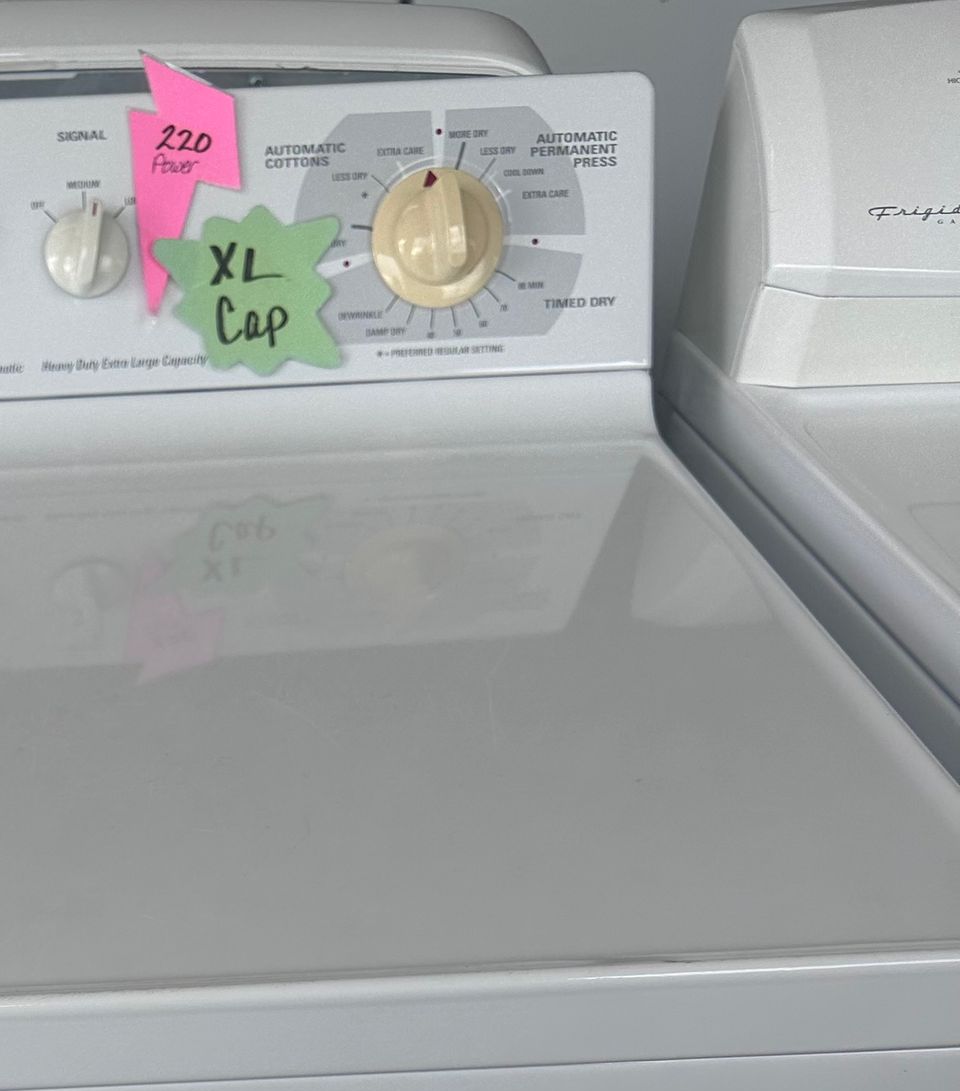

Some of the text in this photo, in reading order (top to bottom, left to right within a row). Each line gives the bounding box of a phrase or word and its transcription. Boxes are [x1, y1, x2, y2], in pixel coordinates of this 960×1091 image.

[56, 130, 107, 143] SIGNAL
[155, 124, 212, 153] 220
[448, 128, 489, 139] MORE DRY
[536, 130, 618, 144] AUTOMATIC
[264, 142, 346, 157] AUTOMATIC
[376, 146, 425, 158] EXTRA CARE
[479, 146, 516, 156] LESS DRY
[530, 143, 618, 157] PERMANENT
[151, 153, 200, 174] Power
[265, 156, 331, 170] COTTONS
[573, 156, 618, 169] PRESS
[331, 172, 368, 182] LESS DRY
[503, 168, 544, 177] COOL DOWN
[522, 189, 569, 200] EXTRA CARE
[208, 241, 286, 287] XL
[545, 296, 616, 310] TIMED DRY
[215, 295, 289, 348] Cap
[338, 311, 382, 321] DEWRINKLE
[365, 326, 407, 337] DAMP DRY
[390, 344, 504, 358] PREFERRED REGULAR SETTING
[76, 358, 99, 373] Duty
[161, 353, 209, 367] Capacity
